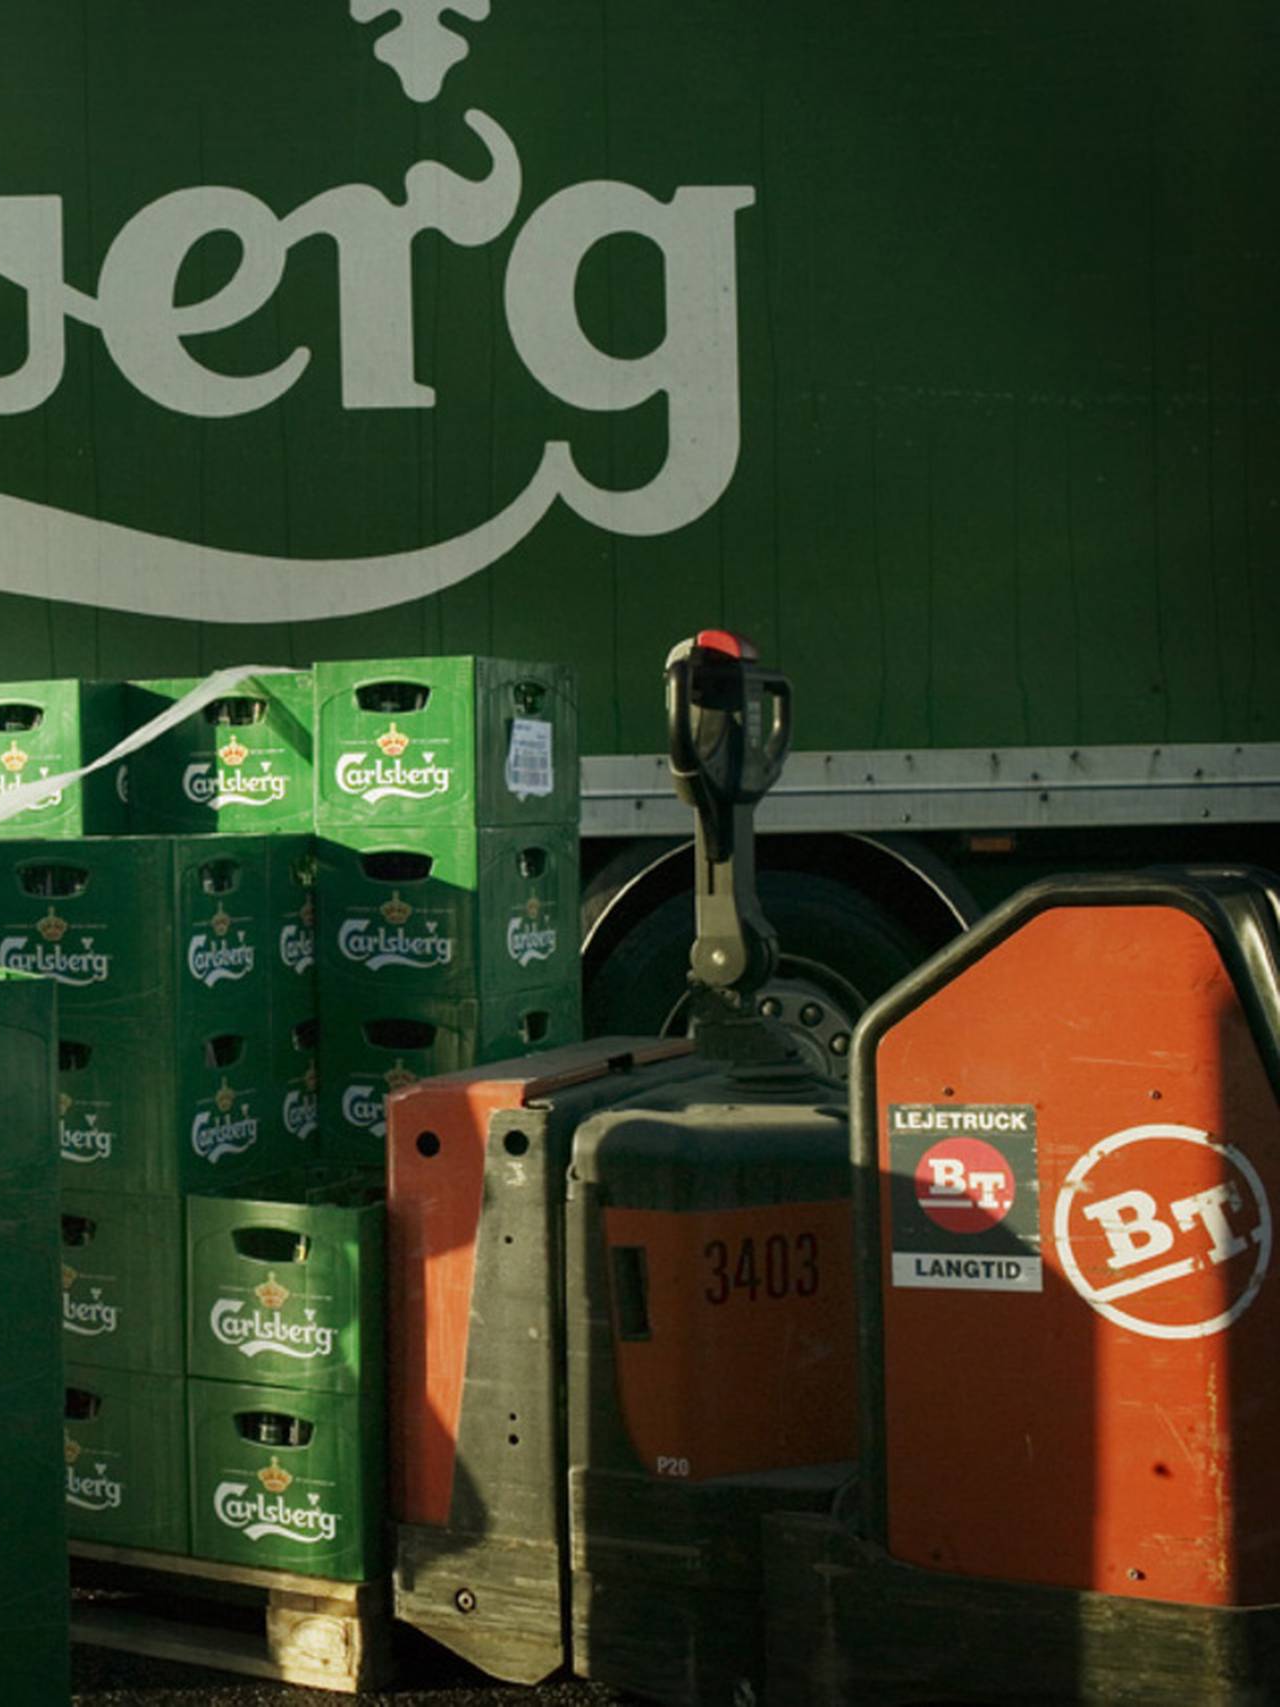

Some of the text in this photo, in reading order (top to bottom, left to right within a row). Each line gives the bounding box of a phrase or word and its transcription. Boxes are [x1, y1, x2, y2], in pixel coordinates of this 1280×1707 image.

[182, 761, 286, 810] Carlsberg
[335, 752, 449, 804] Carlsberg
[188, 930, 254, 988] Carlsberg
[338, 919, 452, 971] Carlsberg
[894, 1111, 1028, 1131] LEJETRUCK
[704, 1232, 818, 1305] 3403
[915, 1258, 1021, 1280] LANGTID
[210, 1298, 333, 1358] Carlsberg
[657, 1456, 690, 1477] P20
[214, 1482, 336, 1543] Carlsberg
